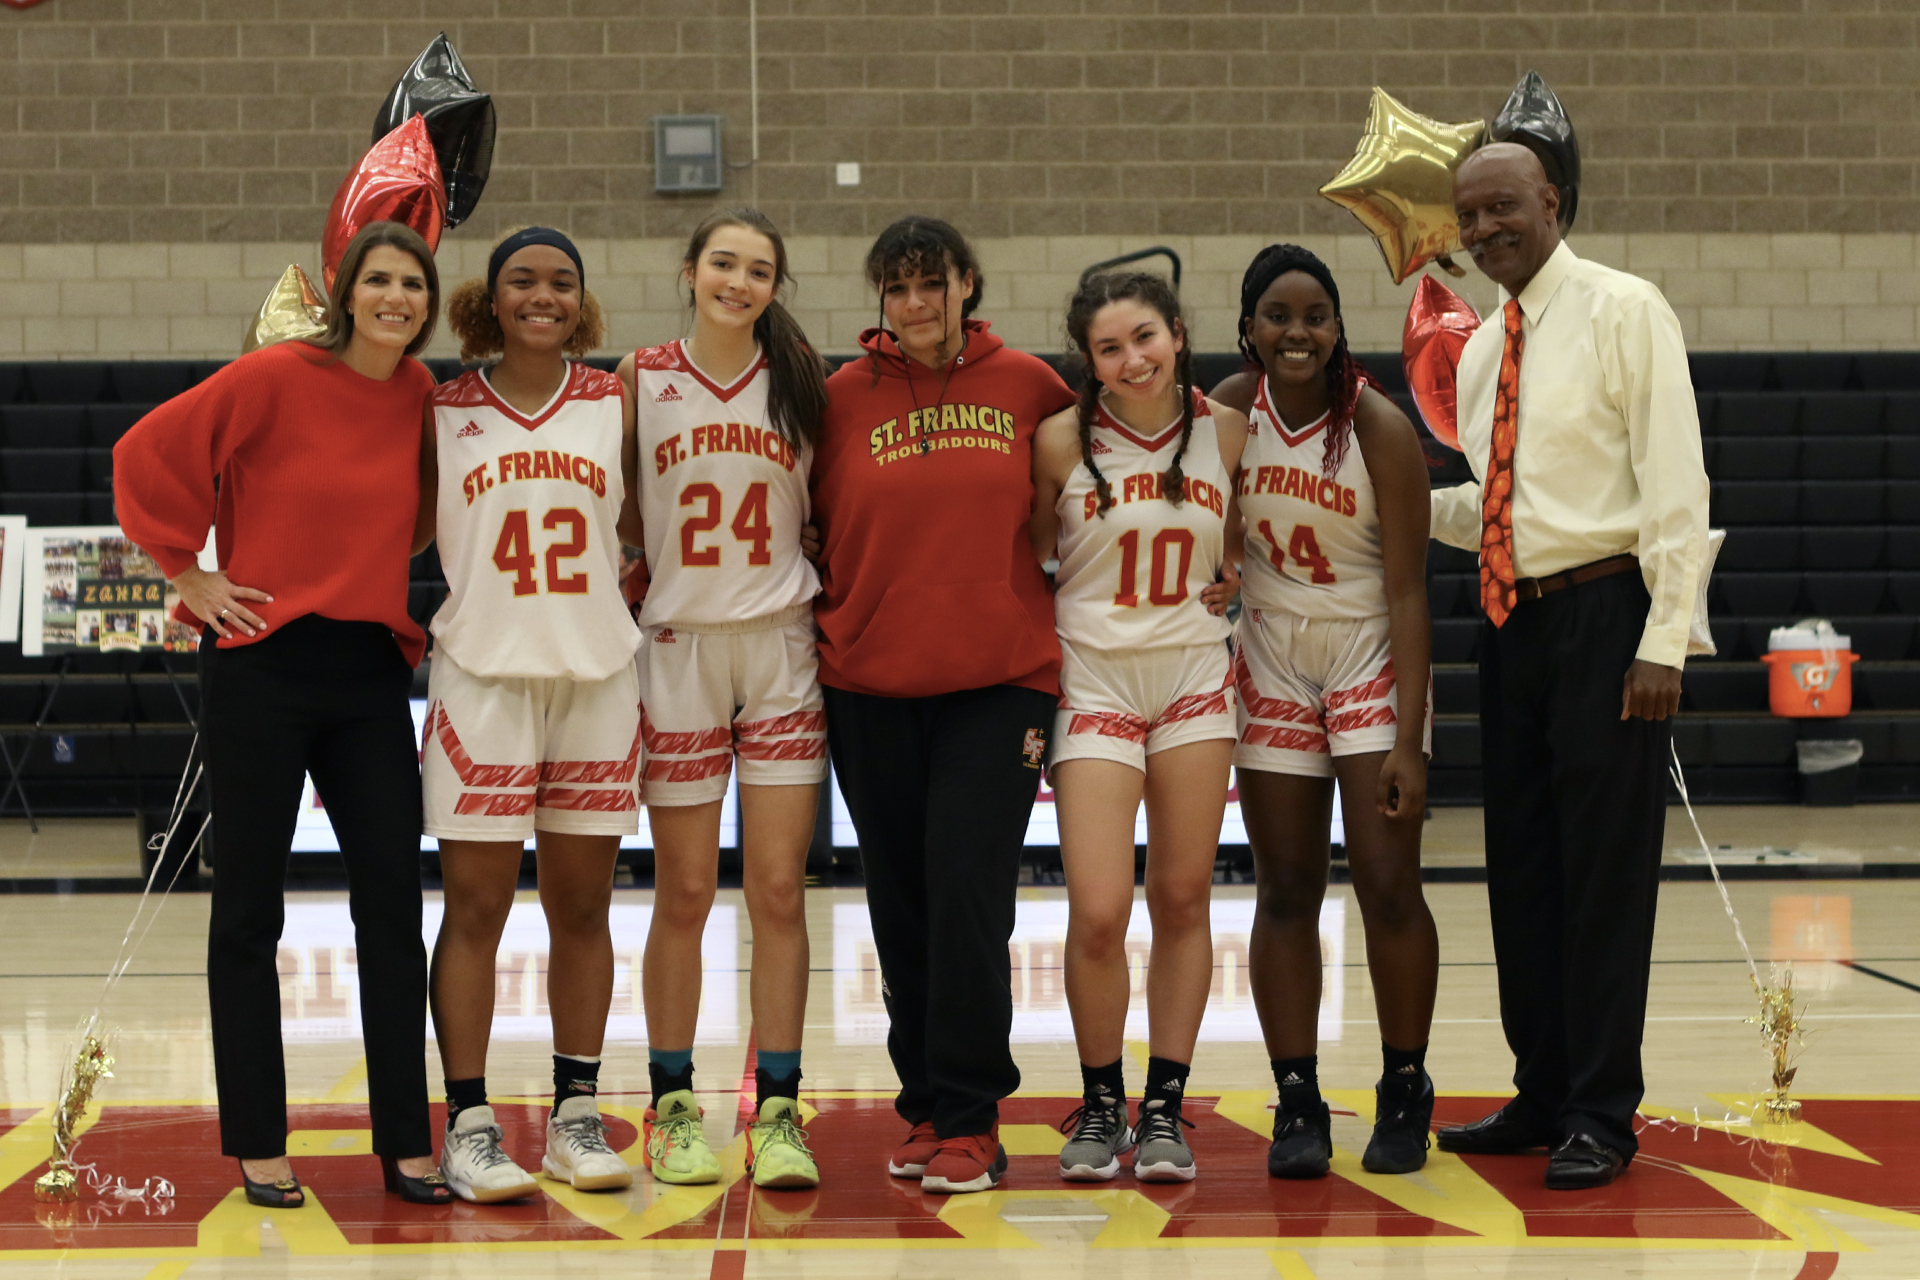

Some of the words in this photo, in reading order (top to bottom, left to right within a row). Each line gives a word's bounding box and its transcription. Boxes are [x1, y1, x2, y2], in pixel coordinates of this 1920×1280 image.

[655, 394, 682, 402] adidas
[457, 429, 484, 438] adidas
[655, 433, 687, 477] ST.
[691, 422, 796, 473] FRANCIS
[870, 416, 904, 457] ST.
[907, 403, 1016, 441] FRANCIS
[876, 436, 1011, 467] TROUBADOURS
[463, 461, 494, 508] ST.
[498, 450, 606, 499] FRANCIS
[1254, 465, 1357, 518] FRANCIS
[678, 481, 772, 567] 24
[491, 507, 589, 598] 42
[1112, 527, 1195, 608] 10
[1257, 518, 1338, 586] 14
[1806, 666, 1825, 685] G
